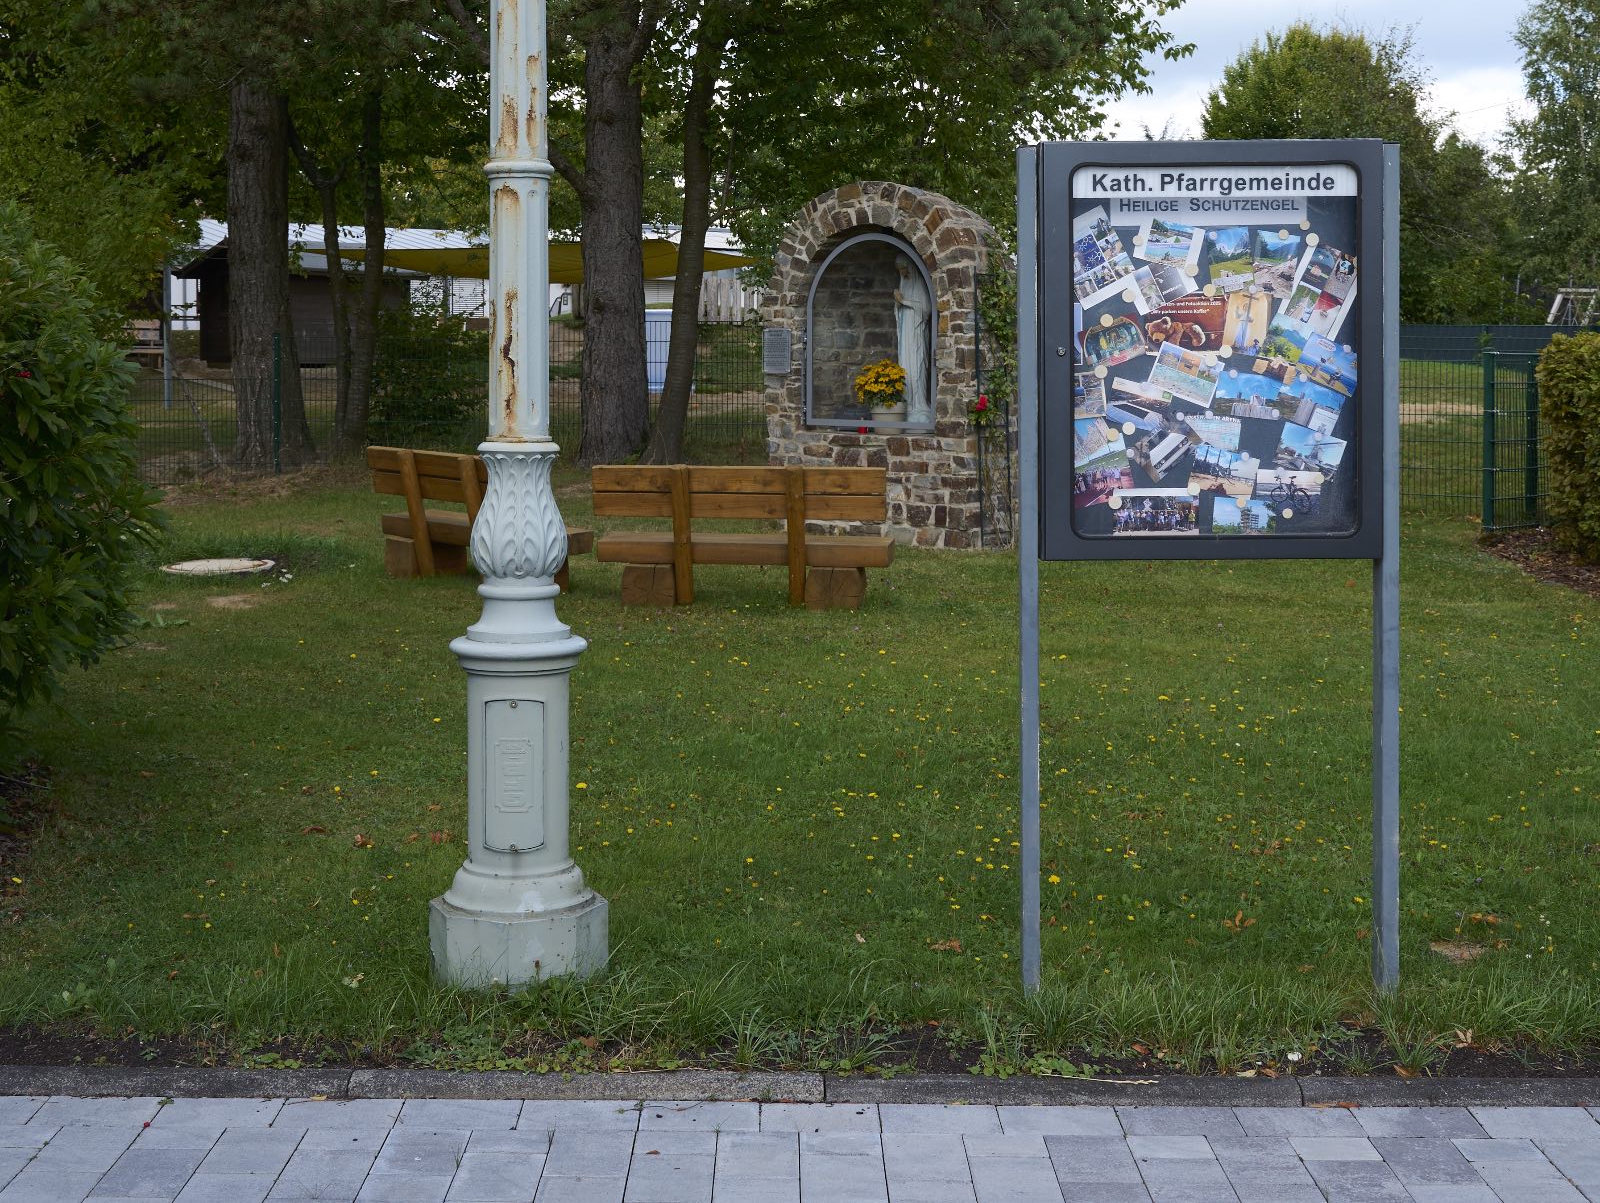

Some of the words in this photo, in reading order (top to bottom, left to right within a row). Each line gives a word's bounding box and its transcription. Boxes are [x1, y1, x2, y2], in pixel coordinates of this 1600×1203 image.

[1092, 173, 1153, 192] Kath.
[1160, 173, 1335, 195] Pfarrgemeinde
[1119, 198, 1179, 212] HEILIGE
[1189, 198, 1300, 212] SCHUTZENGEL
